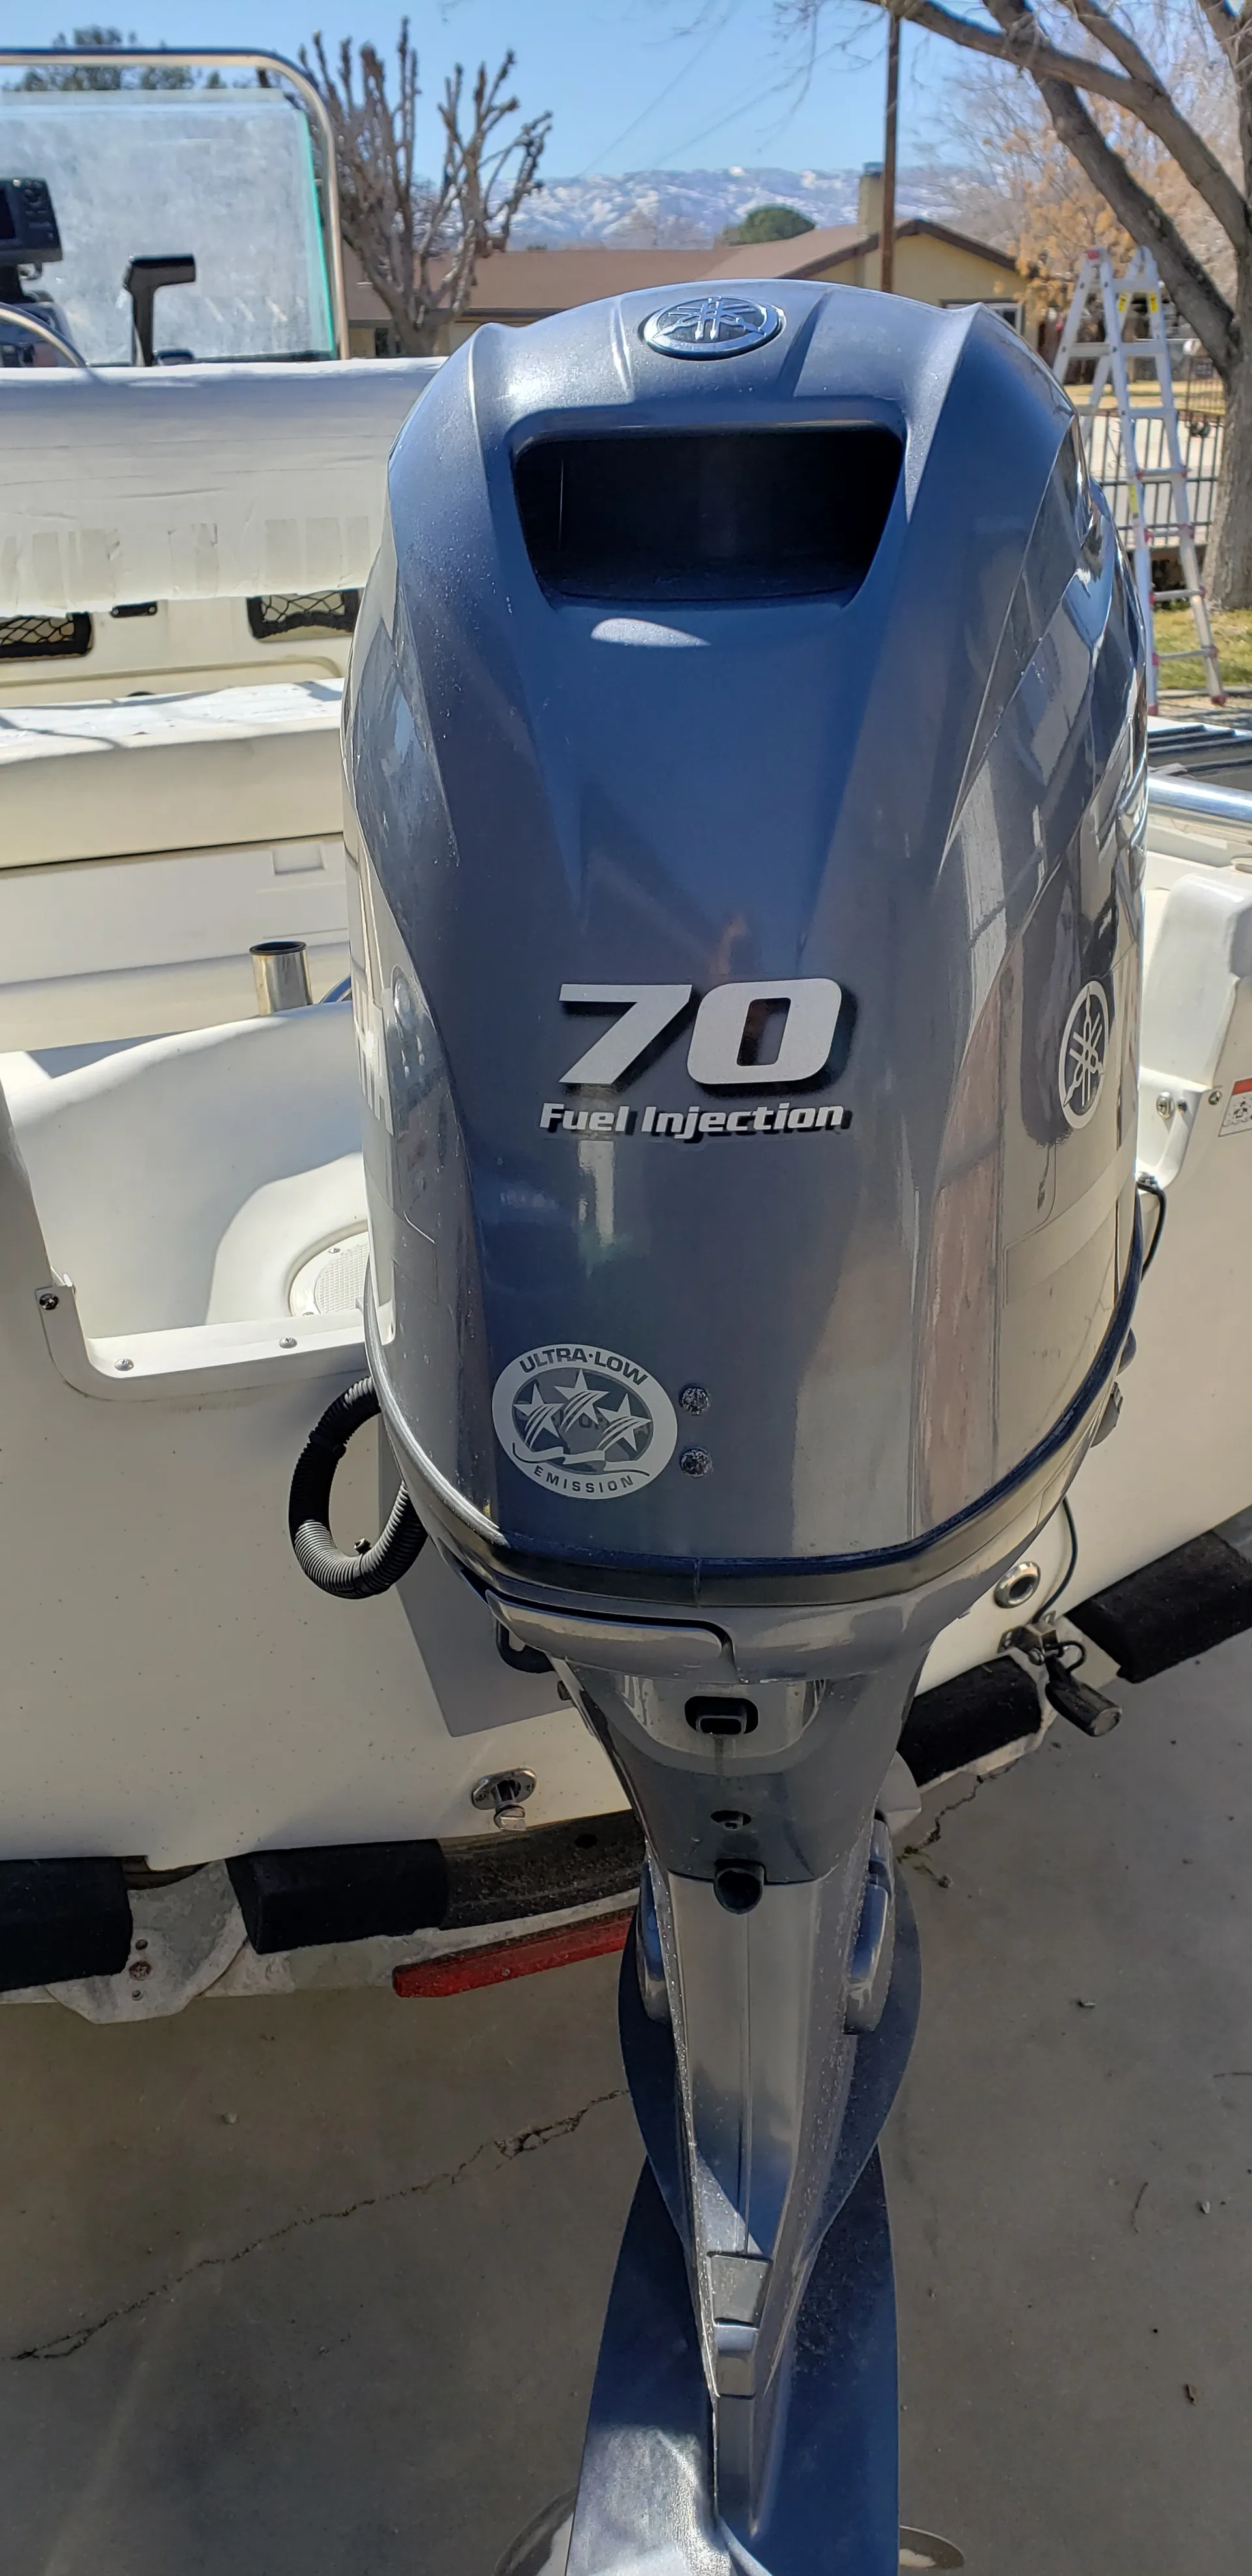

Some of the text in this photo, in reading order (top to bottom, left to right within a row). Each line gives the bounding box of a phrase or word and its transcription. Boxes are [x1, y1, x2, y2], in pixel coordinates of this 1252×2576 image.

[558, 978, 842, 1085] 70
[539, 1102, 844, 1139] Fuel Injection
[533, 1465, 634, 1493] EMISSION
